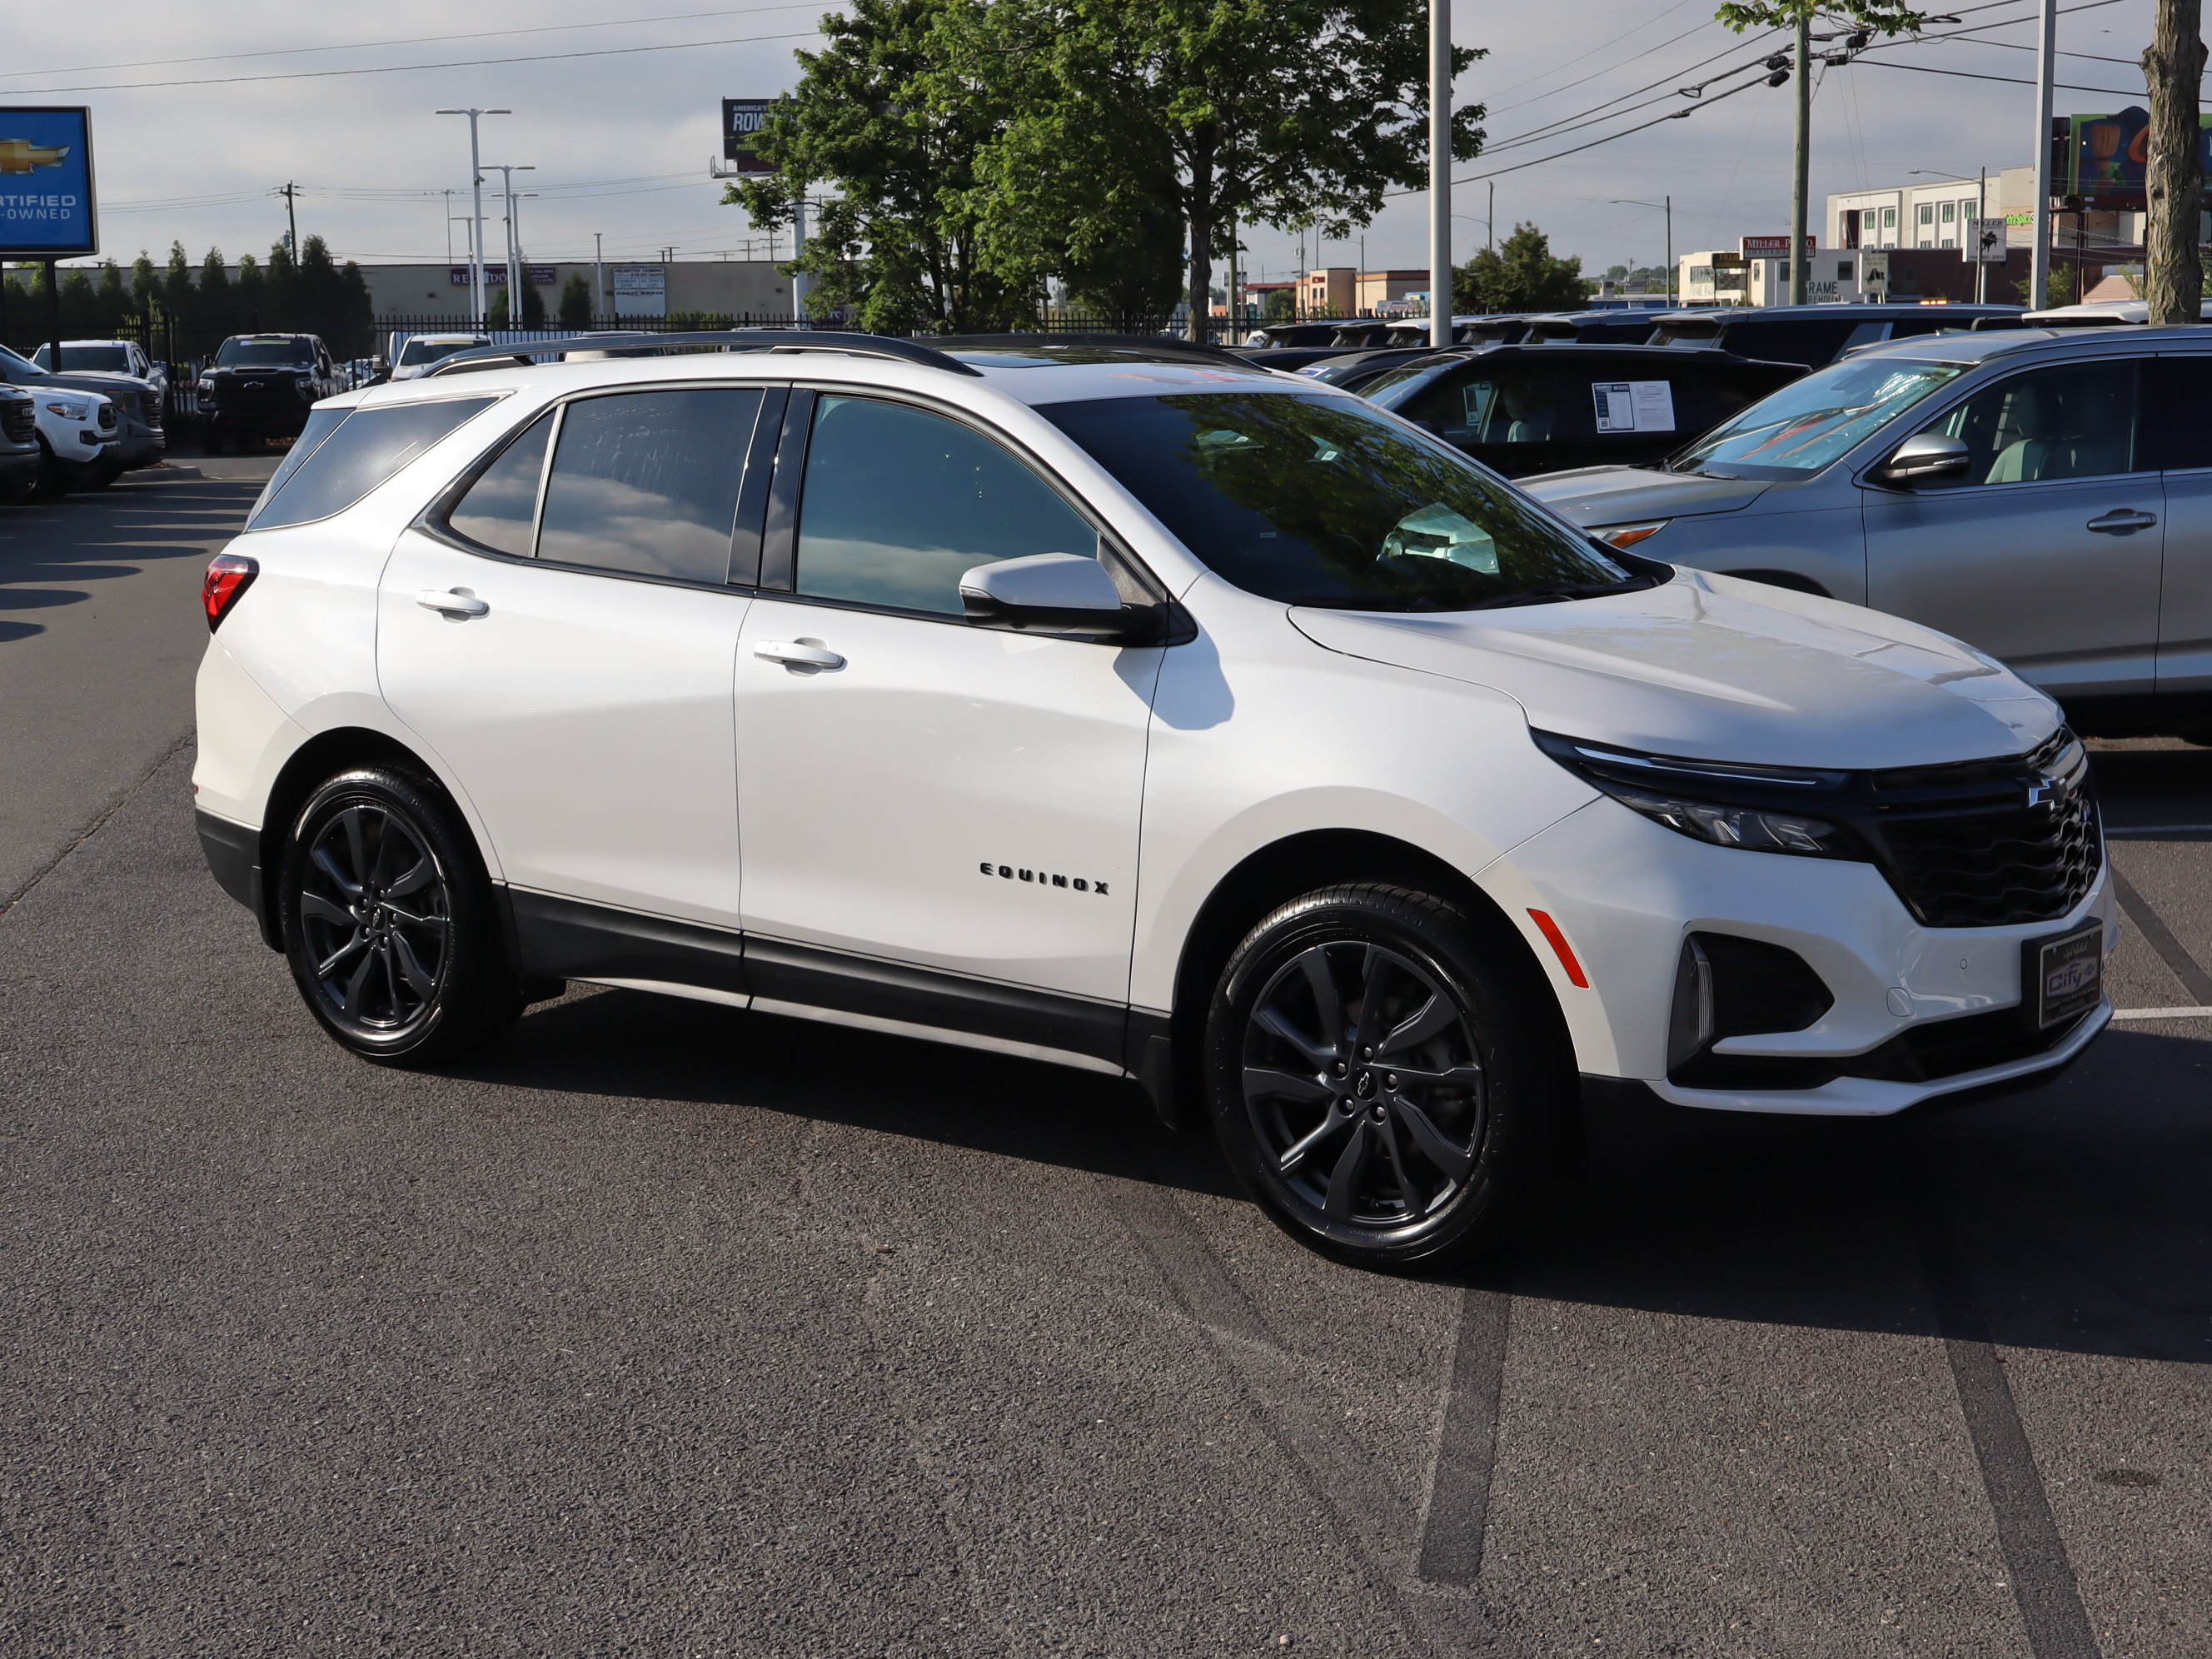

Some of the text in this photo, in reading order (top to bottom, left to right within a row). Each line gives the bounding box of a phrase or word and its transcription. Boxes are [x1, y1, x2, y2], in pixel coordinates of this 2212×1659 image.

[1746, 238, 1781, 249] MILLER
[1808, 282, 1838, 295] RAME
[979, 862, 1109, 896] EQUINOX
